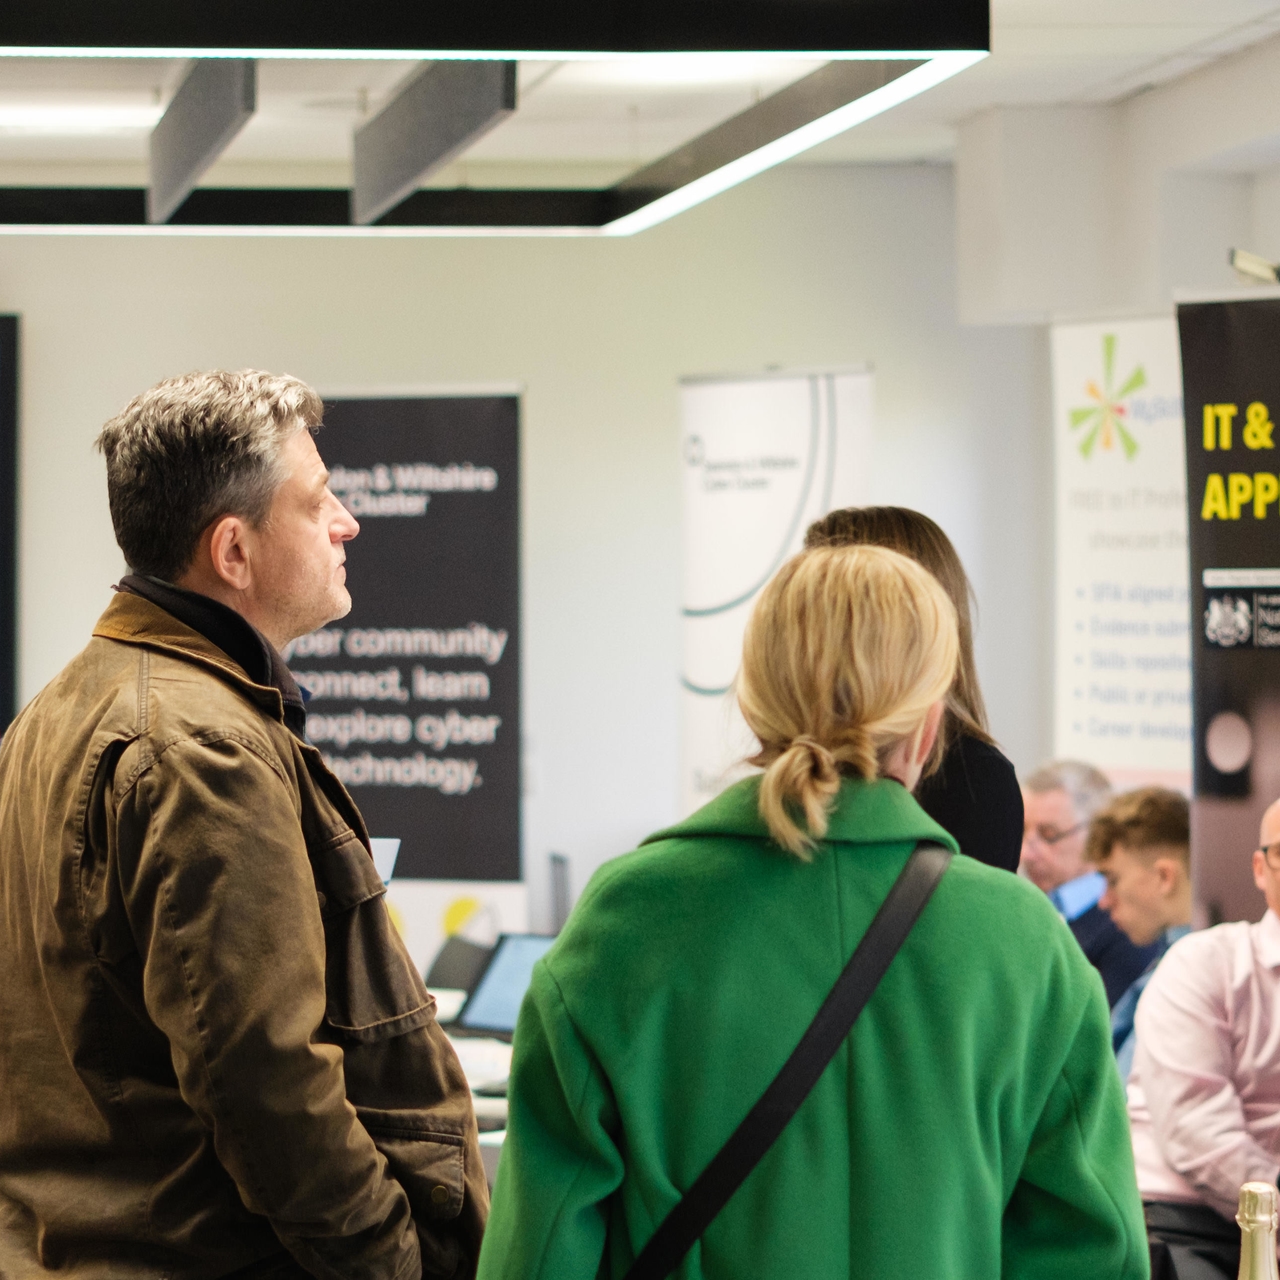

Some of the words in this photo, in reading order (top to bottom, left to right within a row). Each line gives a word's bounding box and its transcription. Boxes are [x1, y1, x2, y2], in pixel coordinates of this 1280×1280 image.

[1202, 403, 1238, 451] IT
[1242, 402, 1275, 450] &
[344, 622, 508, 665] community
[411, 664, 490, 700] learn
[305, 708, 412, 748] explore
[414, 707, 502, 750] cyber
